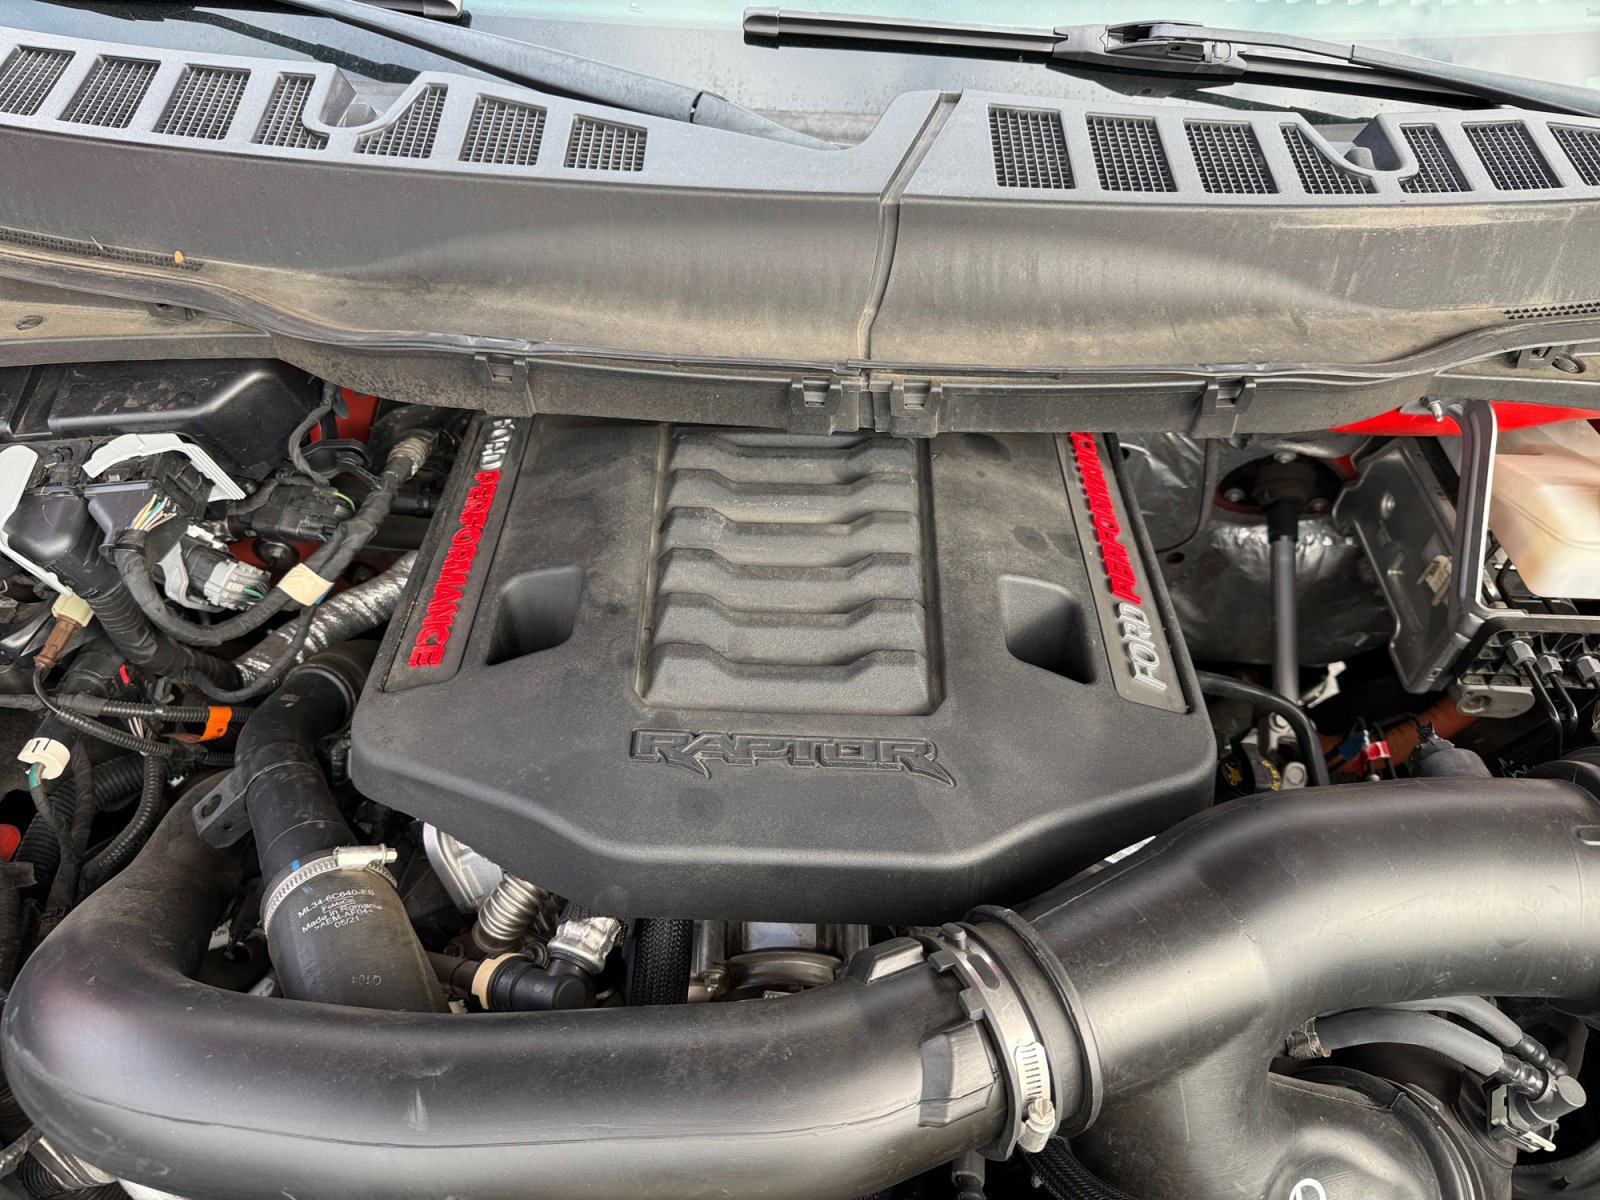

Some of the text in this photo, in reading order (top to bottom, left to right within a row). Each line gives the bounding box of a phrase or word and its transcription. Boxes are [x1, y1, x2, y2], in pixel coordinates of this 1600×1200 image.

[408, 418, 516, 667] FORD PERFORMANCE
[1118, 602, 1168, 692] FORD
[630, 727, 956, 788] RAPTOR
[301, 903, 383, 933] Made in Romania
